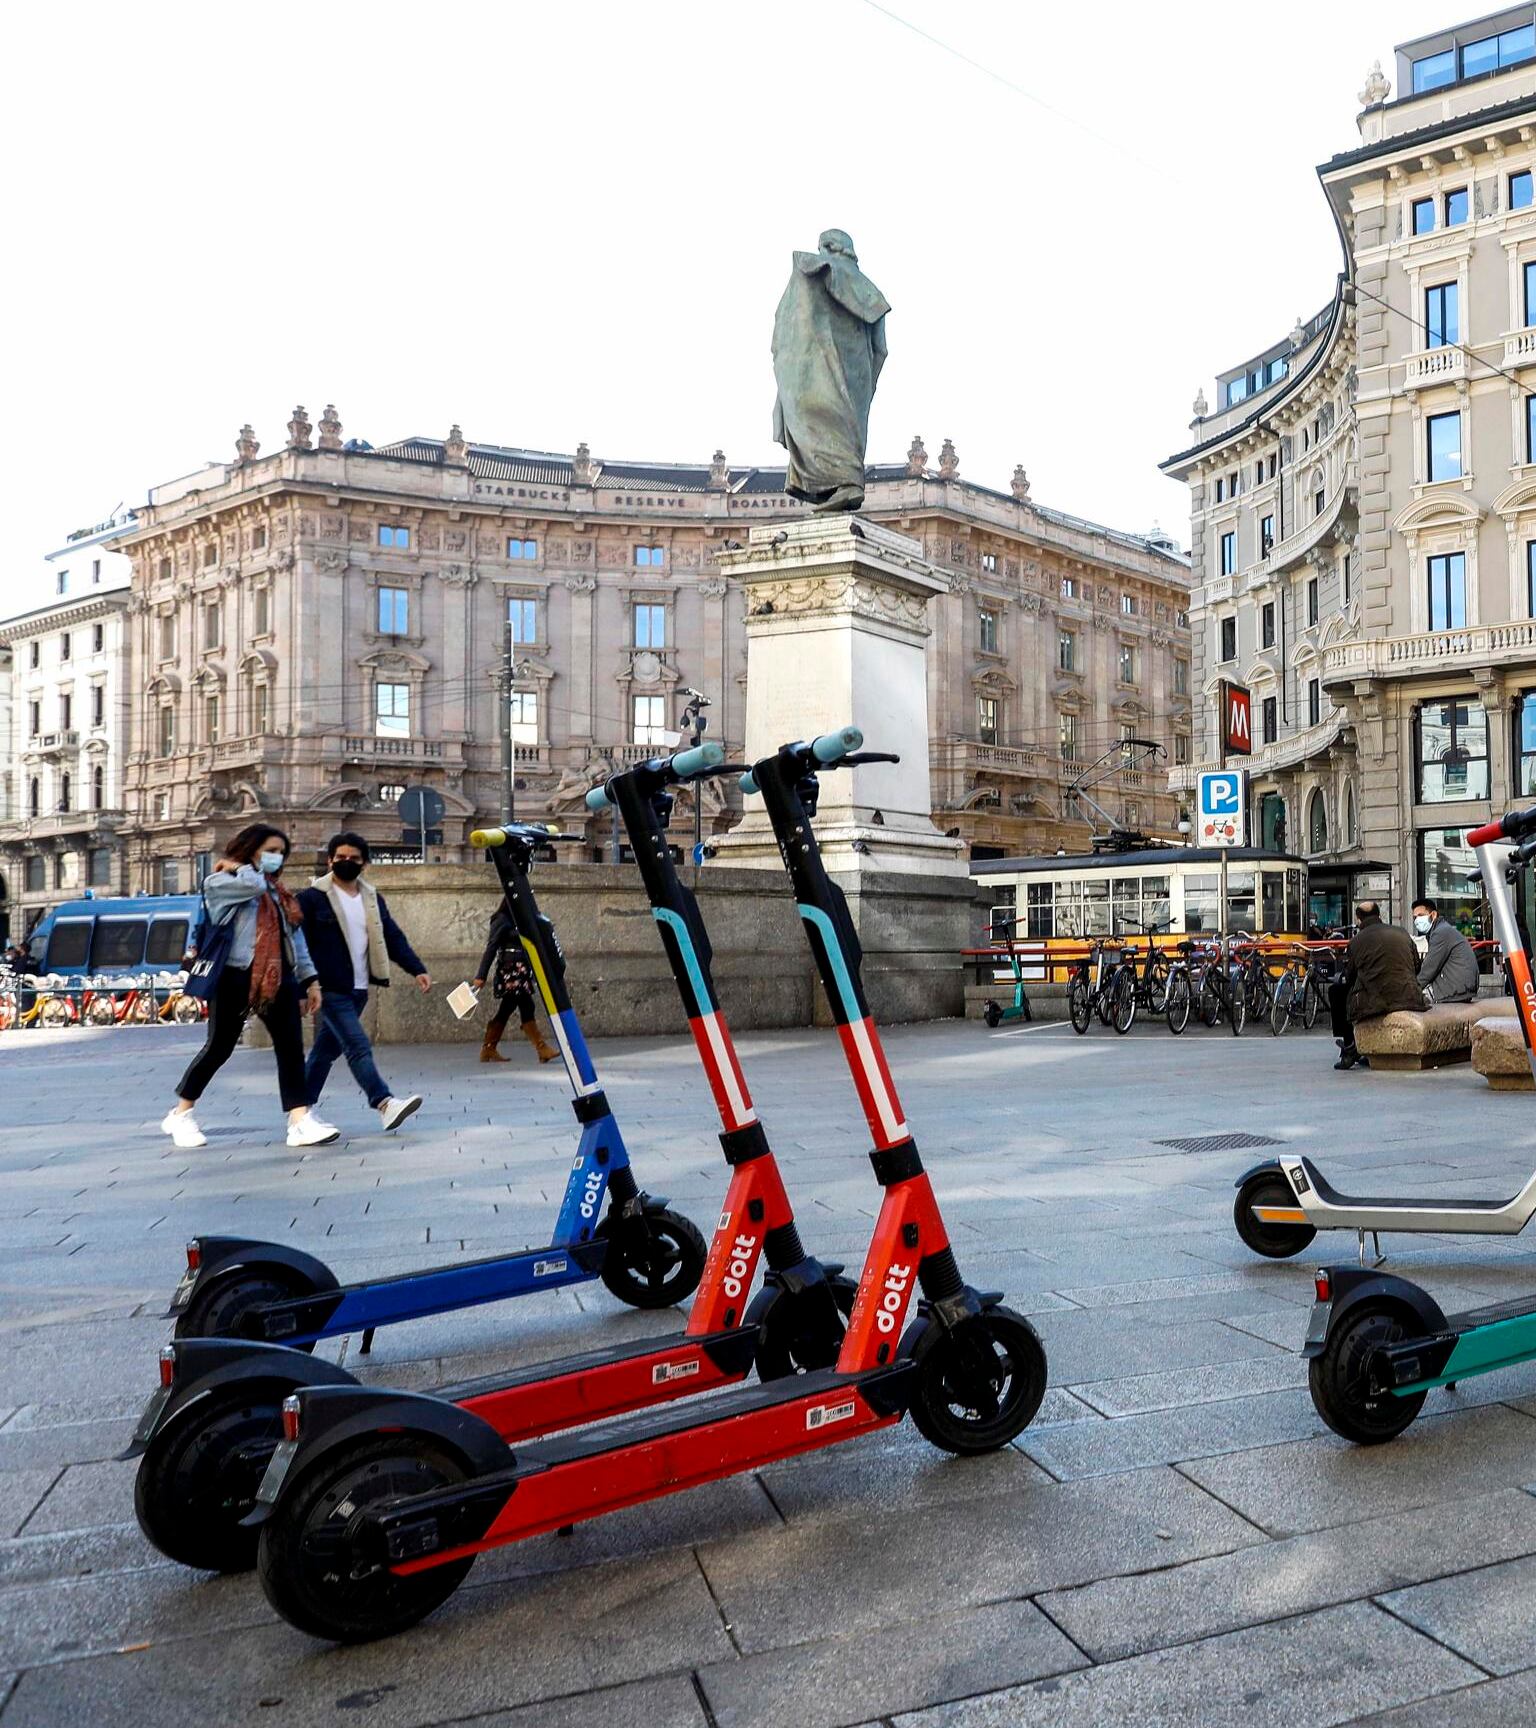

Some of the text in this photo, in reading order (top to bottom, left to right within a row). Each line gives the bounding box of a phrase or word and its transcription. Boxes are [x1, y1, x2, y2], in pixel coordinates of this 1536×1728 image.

[475, 484, 570, 502] STARBUCKS
[615, 496, 686, 508] RESERVE
[1230, 700, 1249, 740] M
[1210, 779, 1232, 810] P
[1288, 869, 1298, 882] 19
[580, 1170, 604, 1218] dott
[722, 1233, 757, 1298] dott
[876, 1262, 912, 1334] dott
